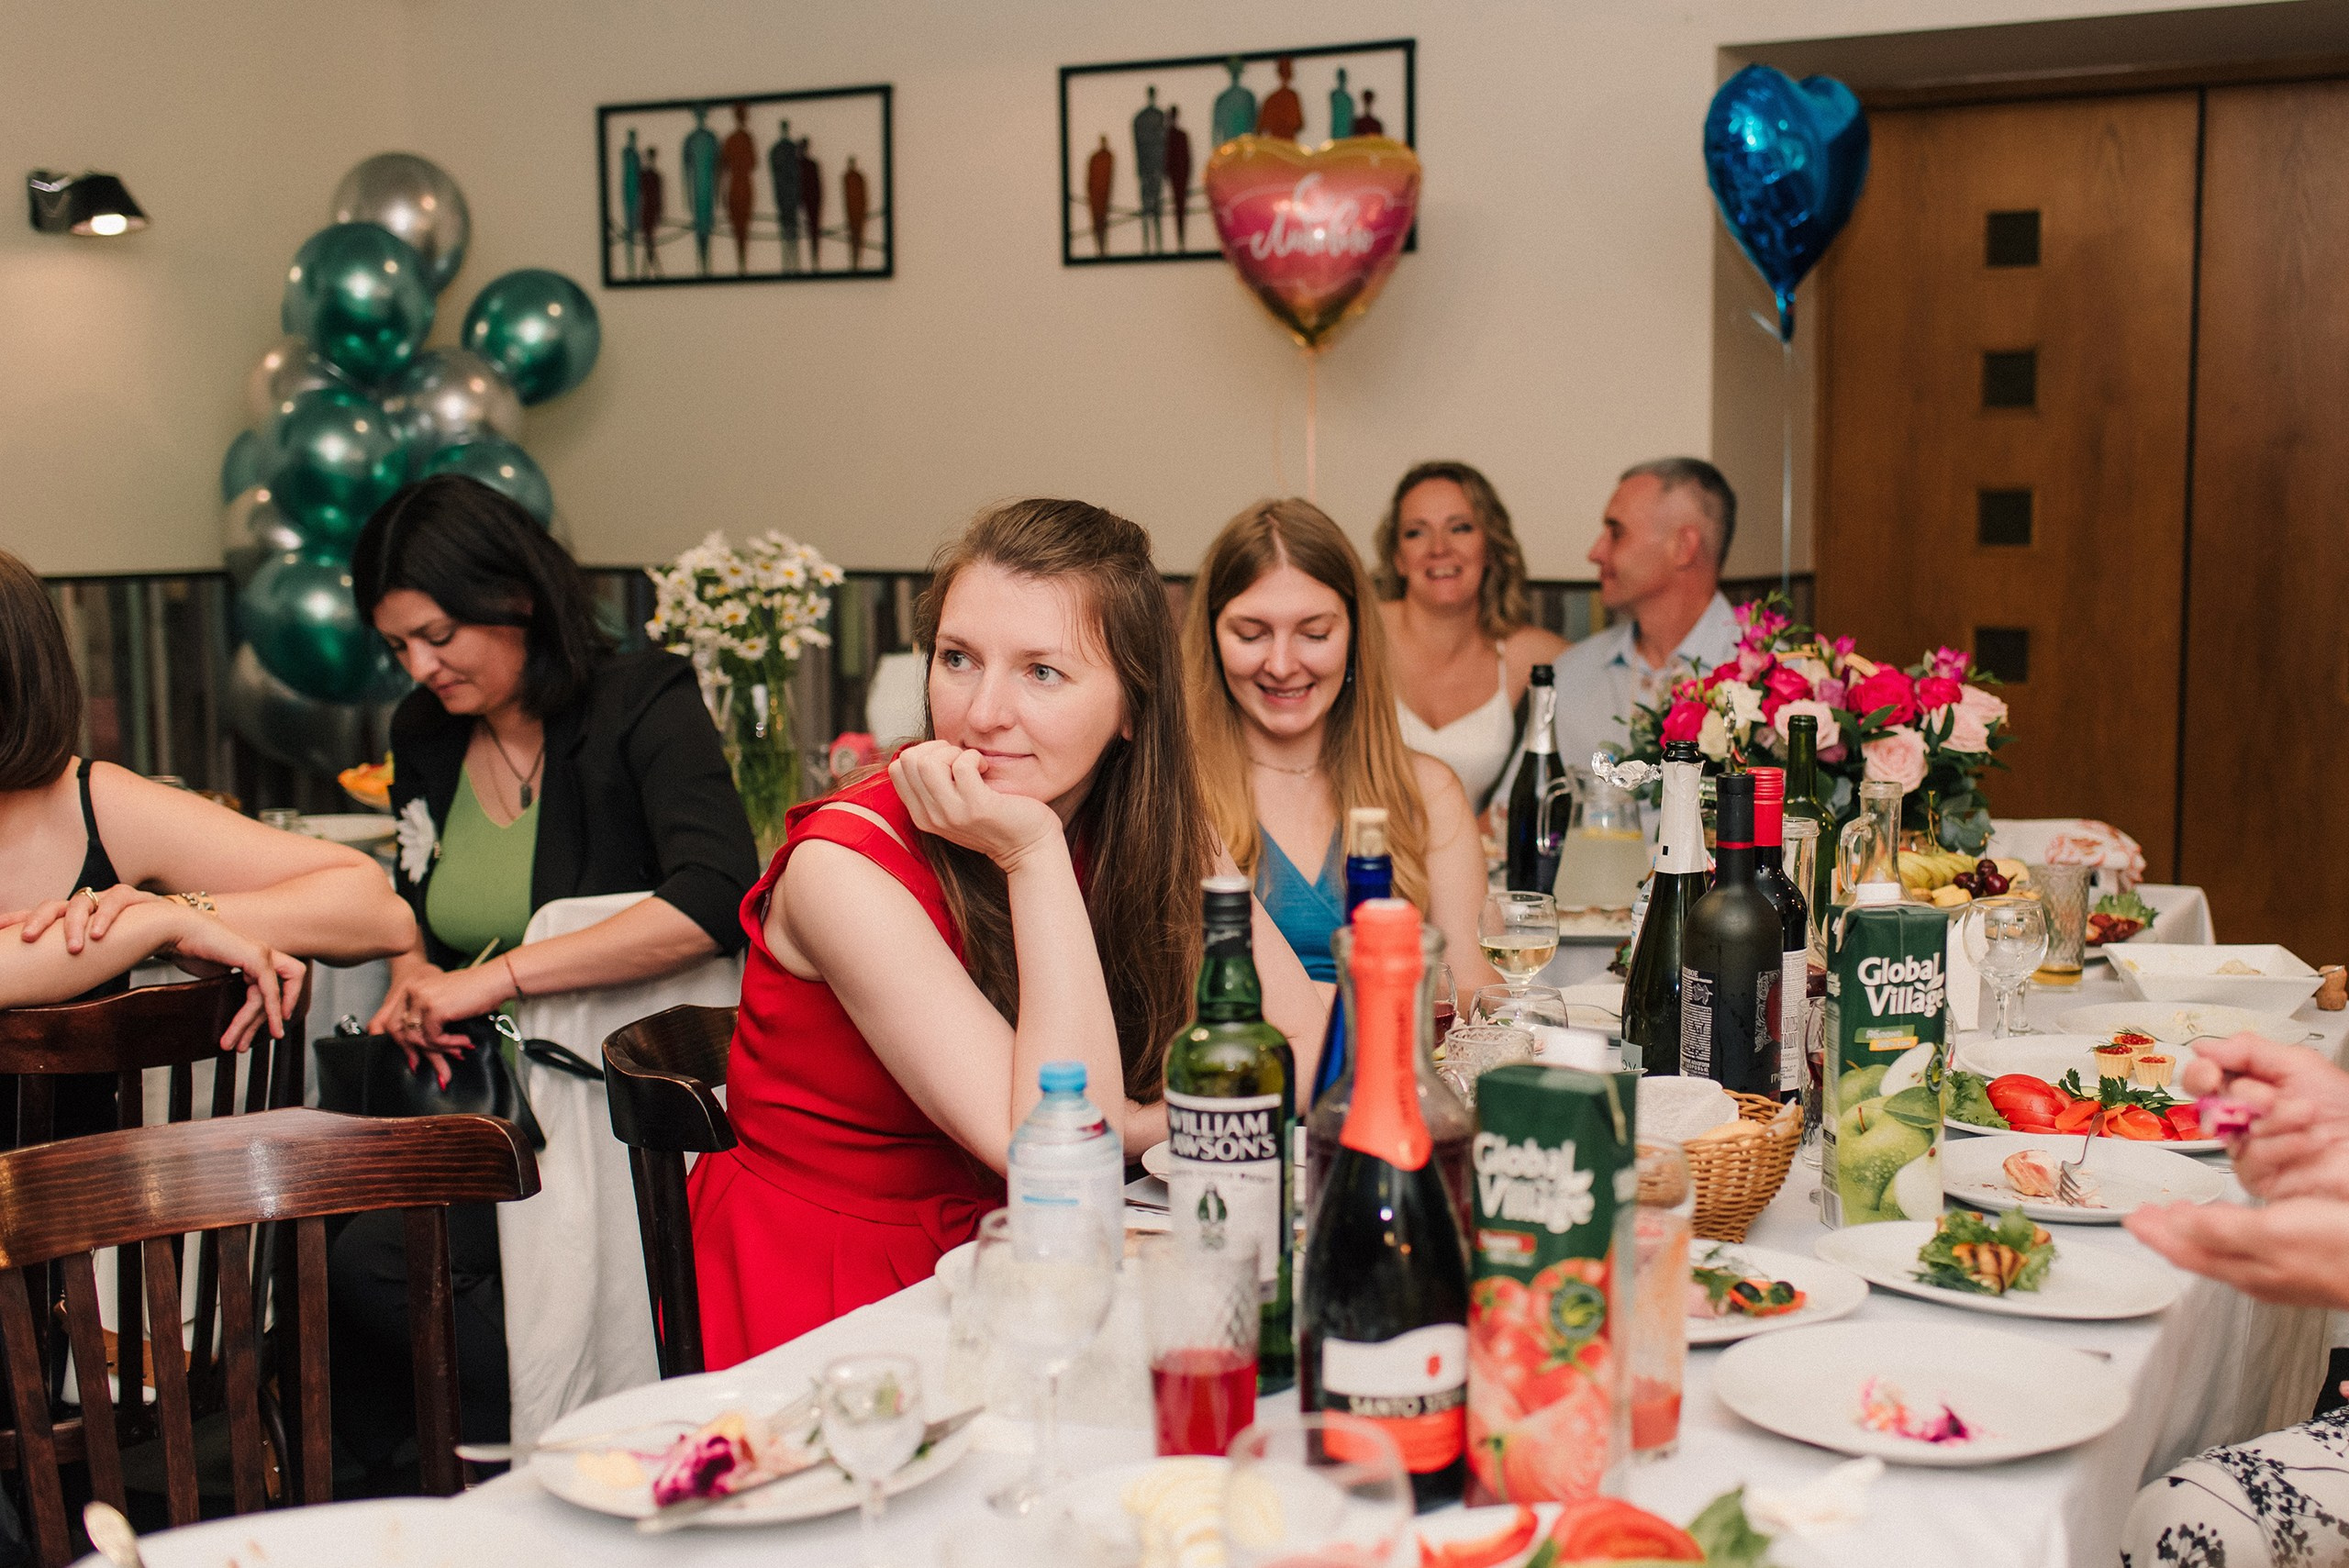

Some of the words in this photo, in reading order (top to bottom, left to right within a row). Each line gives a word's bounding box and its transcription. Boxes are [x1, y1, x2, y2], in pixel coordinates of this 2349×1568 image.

[1857, 951, 1943, 986] Global
[1865, 985, 1944, 1018] Village
[1168, 1107, 1269, 1138] WILLIAM
[1170, 1132, 1277, 1162] AWSON'S
[1473, 1132, 1576, 1179] Global
[1478, 1173, 1596, 1234] Village
